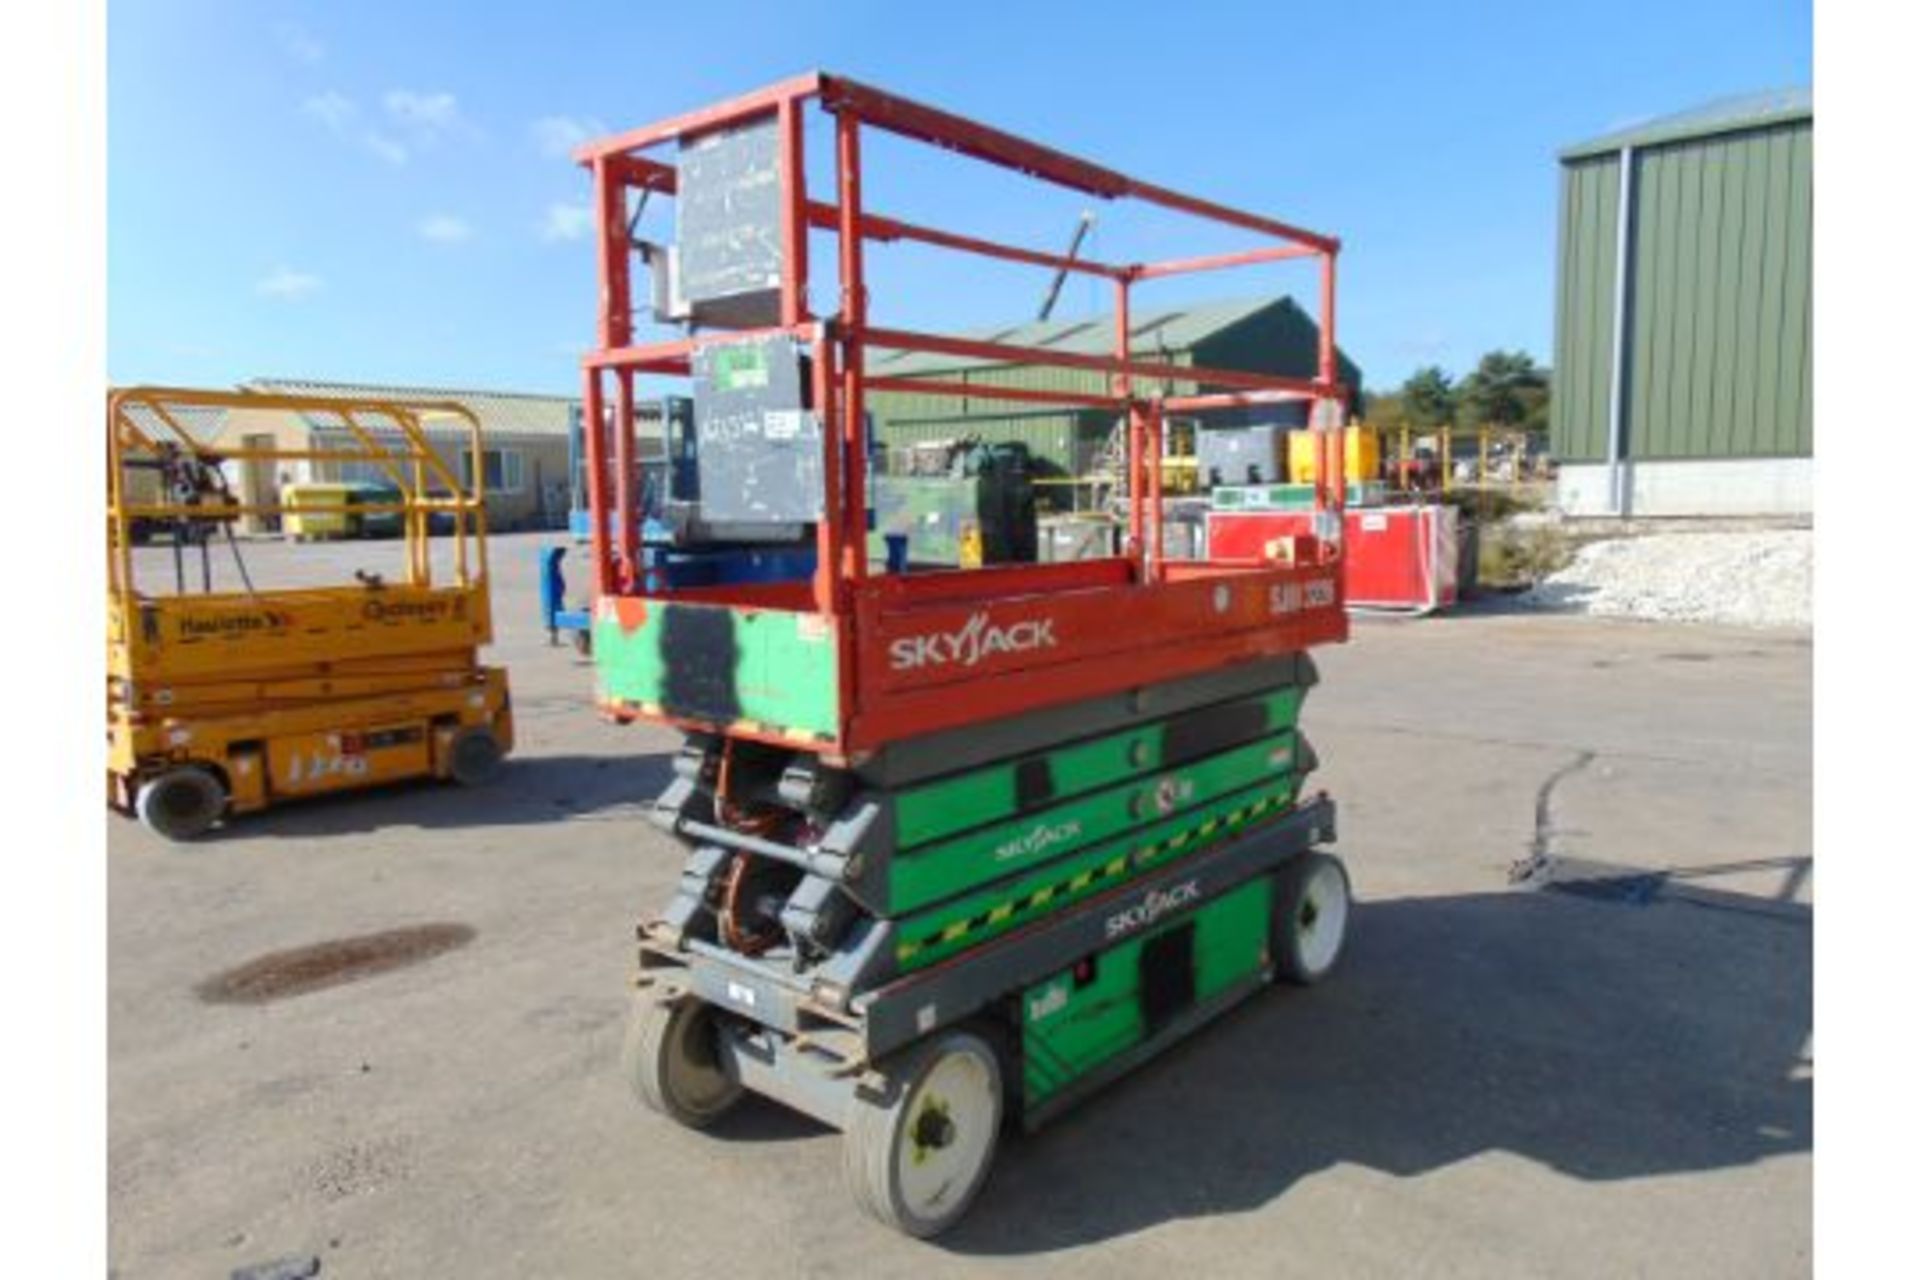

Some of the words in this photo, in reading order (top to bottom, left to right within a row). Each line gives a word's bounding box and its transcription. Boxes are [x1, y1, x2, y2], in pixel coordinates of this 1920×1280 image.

[889, 612, 1056, 669] SKYJACK
[995, 821, 1081, 861] SKYJACK
[1105, 880, 1200, 938] SKYJACK
